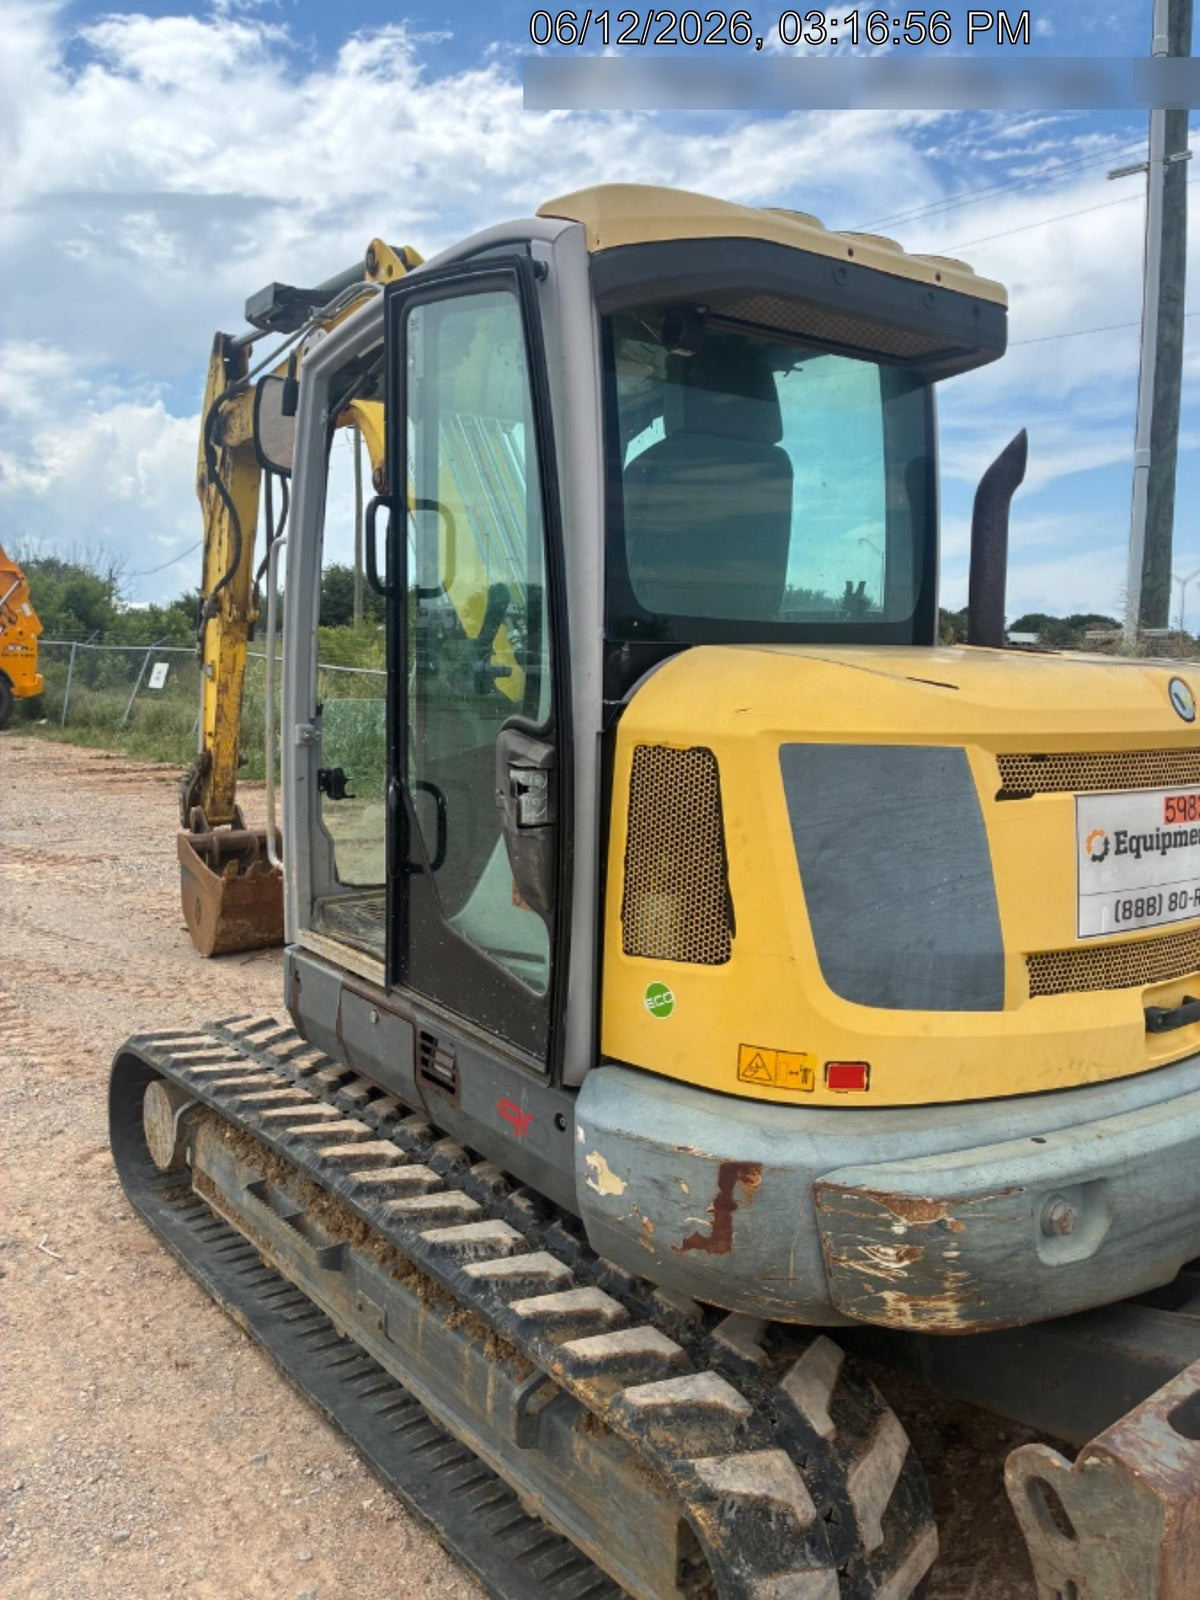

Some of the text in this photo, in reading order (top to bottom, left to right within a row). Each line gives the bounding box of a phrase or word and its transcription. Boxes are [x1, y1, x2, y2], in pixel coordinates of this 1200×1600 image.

[1165, 795, 1200, 823] 598
[1114, 827, 1200, 859] Equipme
[1114, 893, 1163, 923] (888)
[647, 991, 673, 1009] ECO
